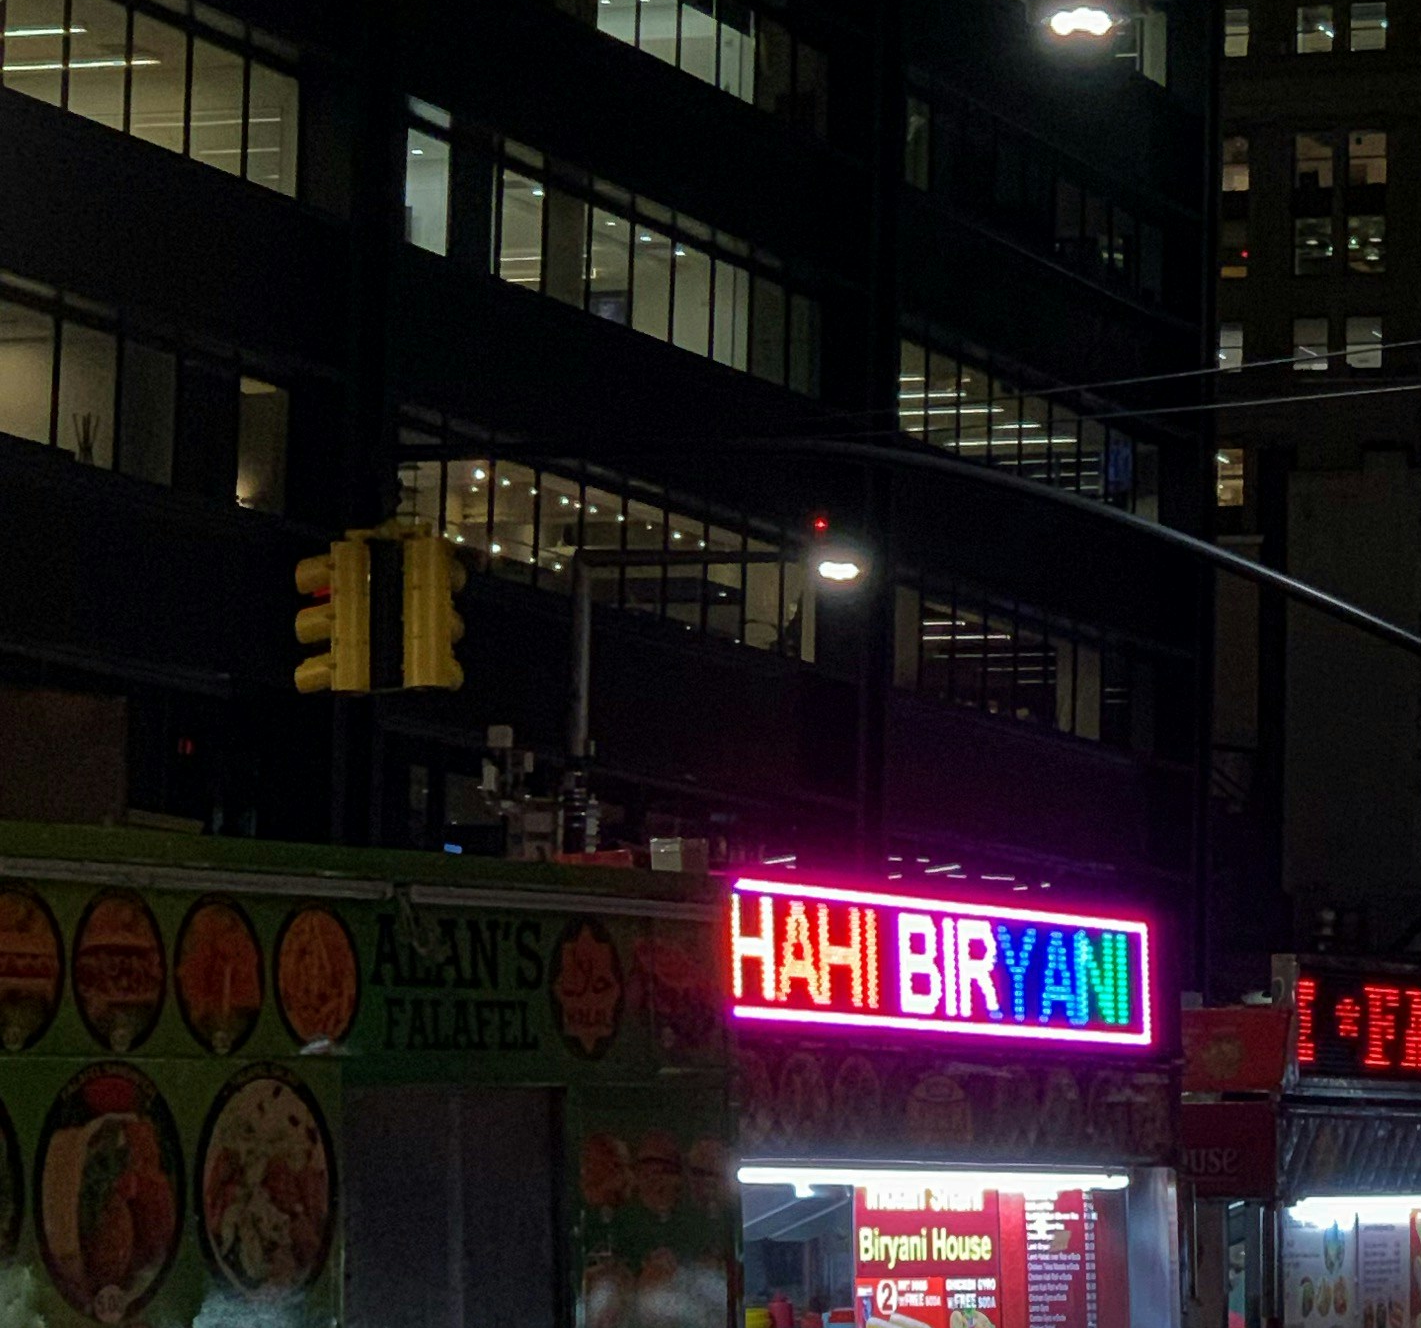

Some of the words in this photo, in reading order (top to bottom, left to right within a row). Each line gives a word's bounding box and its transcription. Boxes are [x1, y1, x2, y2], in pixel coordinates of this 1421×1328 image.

[369, 913, 544, 990] ALAN'S
[731, 893, 879, 1010] HAHI
[898, 911, 1129, 1025] BIRYANI
[384, 996, 540, 1051] FALAFEL
[858, 1226, 928, 1270] Biryani
[931, 1226, 993, 1261] House
[880, 1281, 894, 1311] 2
